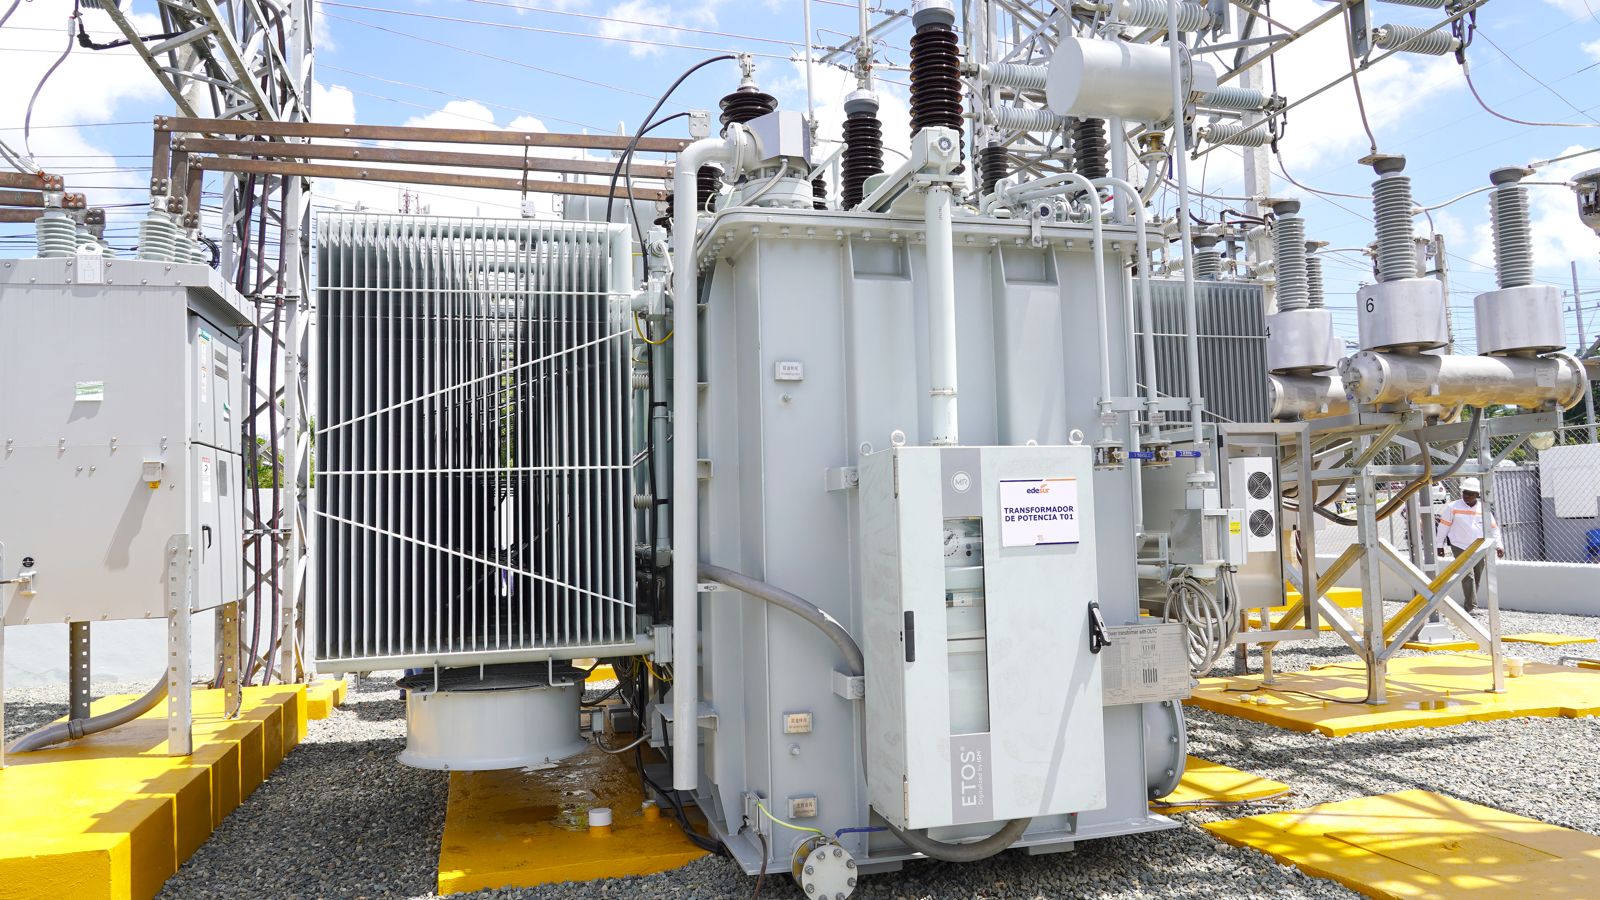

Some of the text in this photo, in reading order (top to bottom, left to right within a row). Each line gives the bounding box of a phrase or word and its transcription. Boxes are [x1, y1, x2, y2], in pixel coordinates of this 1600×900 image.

[1365, 297, 1375, 313] 6
[1026, 486, 1050, 494] edesur
[1004, 505, 1074, 514] TRANSFORMADOR
[1018, 514, 1057, 522] POTENCIA
